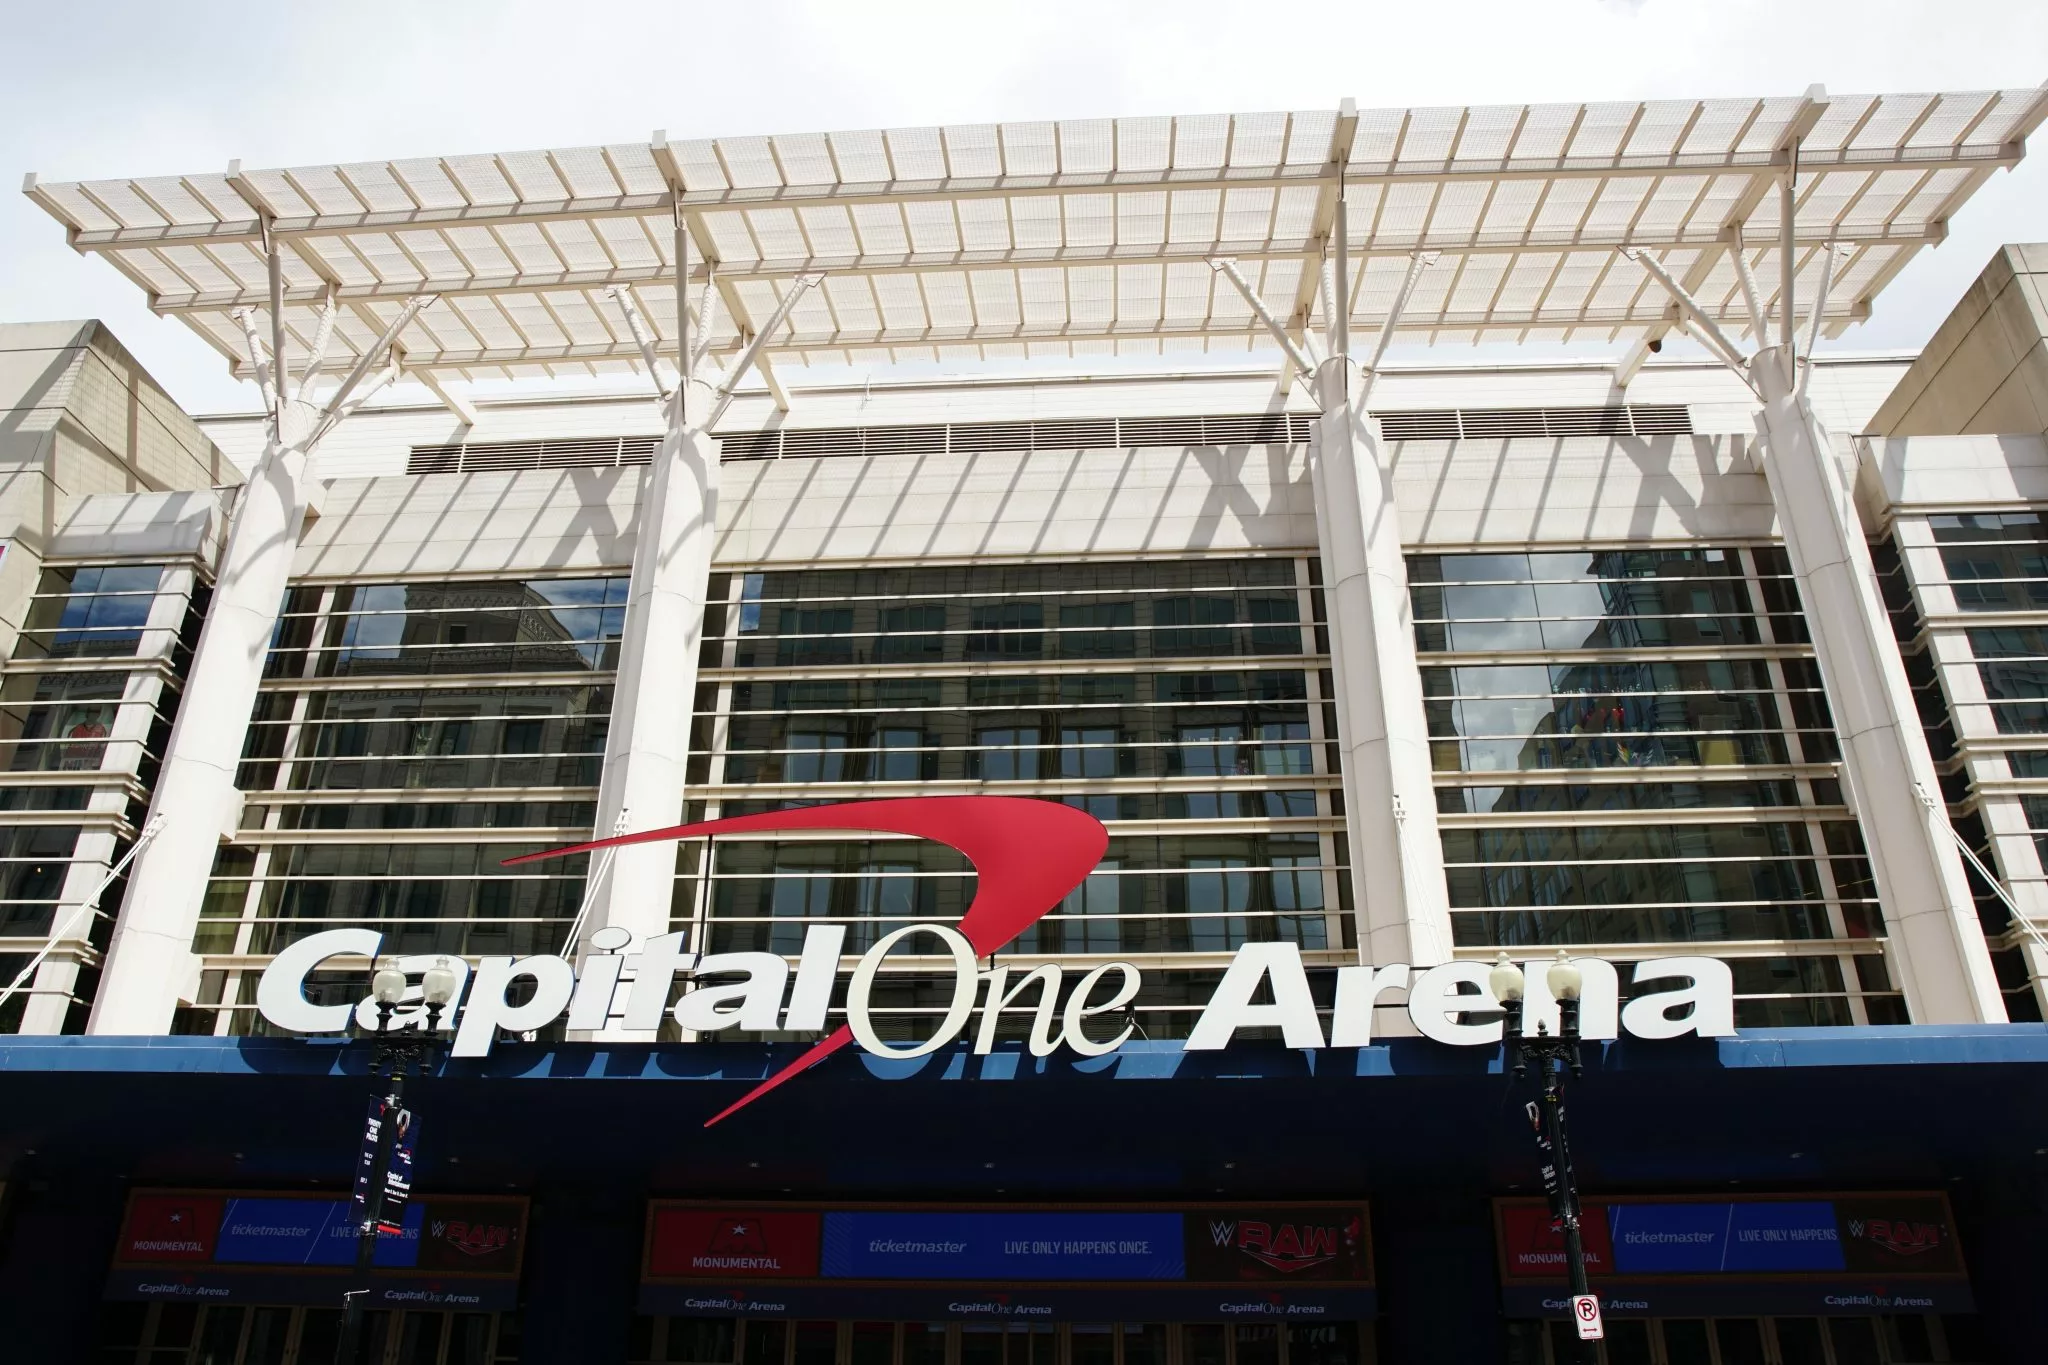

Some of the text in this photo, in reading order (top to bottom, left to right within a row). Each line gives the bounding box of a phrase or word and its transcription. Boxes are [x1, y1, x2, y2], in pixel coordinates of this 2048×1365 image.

[1183, 941, 1738, 1050] Arena
[231, 1223, 311, 1237] ticketmaster
[330, 1226, 352, 1239] LIVE
[446, 1219, 510, 1248] RAW
[1738, 1227, 1838, 1242] LIVE ONLY HAPPENS
[1866, 1218, 1940, 1246] RAW
[1238, 1219, 1338, 1258] RAW
[1624, 1231, 1715, 1244] ticketmaster
[133, 1240, 204, 1252] MONUMENTAL
[869, 1239, 967, 1253] ticketmaster
[1004, 1240, 1152, 1255] LIVE ONLY HAPPENS ONCE.
[692, 1256, 781, 1270] MONUMENTAL
[1519, 1253, 1601, 1264] MONUMTAL
[196, 1286, 231, 1297] Arena
[444, 1293, 481, 1304] Arena
[1610, 1299, 1649, 1309] Arena
[1894, 1296, 1934, 1307] Arena
[748, 1301, 785, 1312] Arena
[1014, 1304, 1052, 1315] Arena
[1286, 1304, 1325, 1314] Arena
